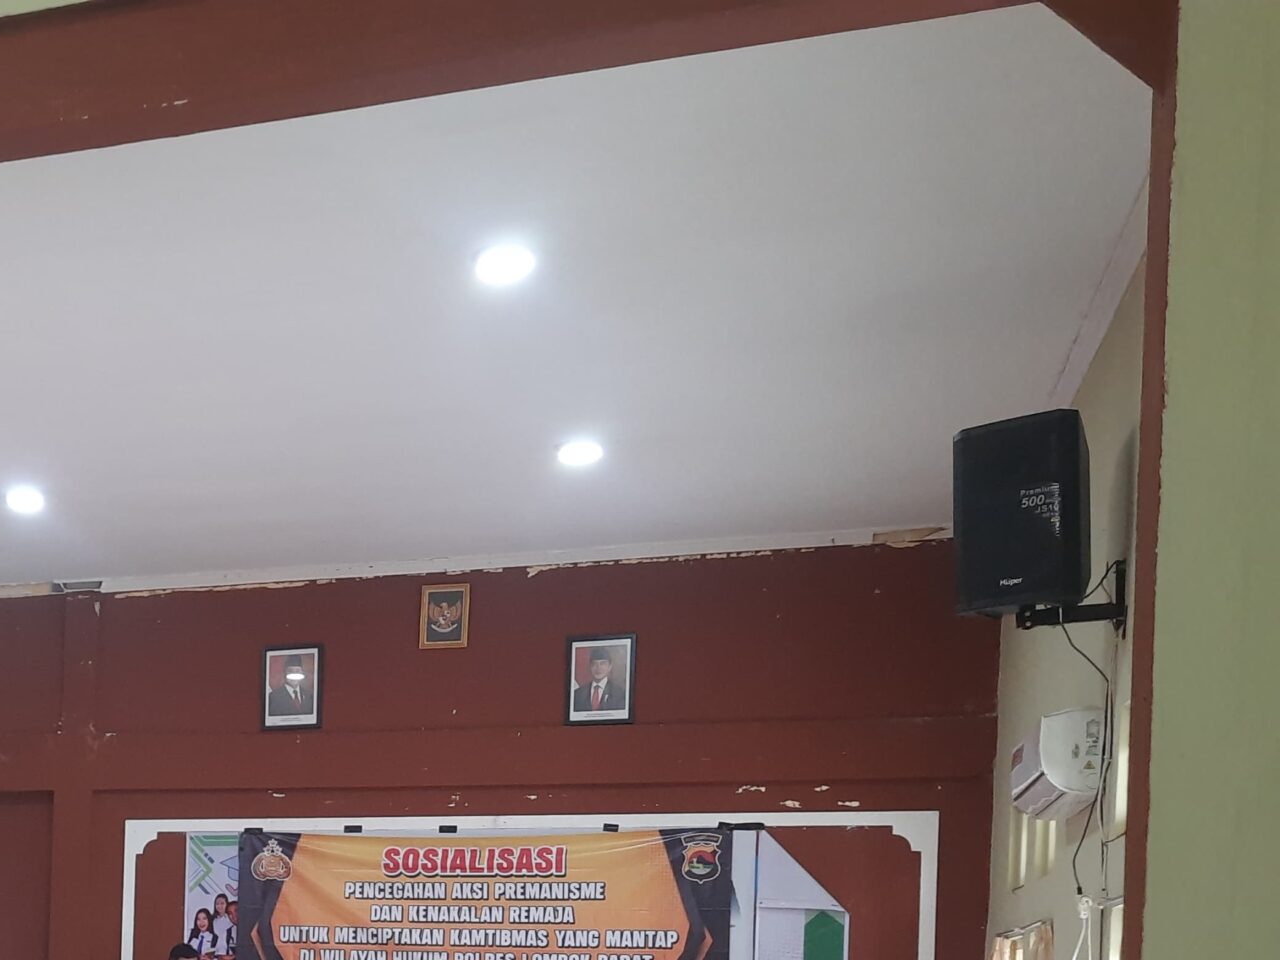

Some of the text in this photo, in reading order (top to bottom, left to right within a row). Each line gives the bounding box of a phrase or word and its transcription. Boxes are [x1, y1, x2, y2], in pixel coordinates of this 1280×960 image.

[1021, 494, 1045, 508] 500
[383, 846, 566, 876] SOSIALISASI
[344, 882, 605, 900] PENCEGAHAN AKSI PREMANISME
[371, 905, 574, 923] DAN KENAKALAN REMAJA
[279, 926, 678, 948] UNTUK MENCIPTAKAN KAMTIBMAS YANG MANTAP
